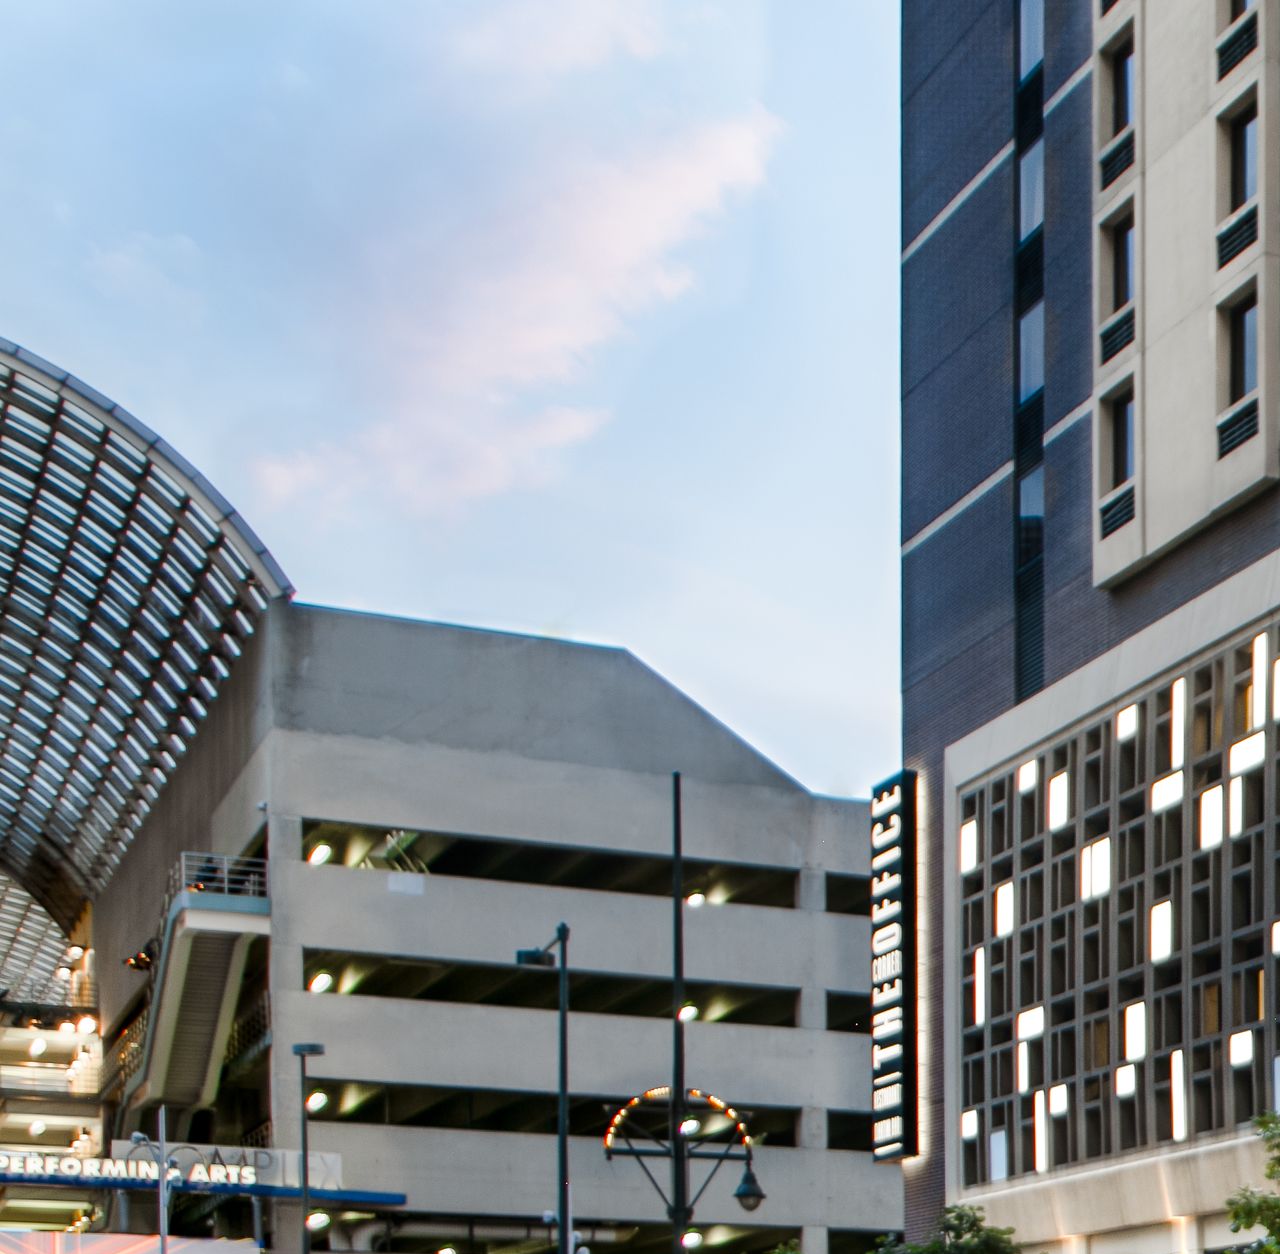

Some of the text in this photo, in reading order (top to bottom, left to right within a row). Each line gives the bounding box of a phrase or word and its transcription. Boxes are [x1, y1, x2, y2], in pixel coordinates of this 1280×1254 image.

[871, 783, 903, 957] OFFICE
[871, 979, 904, 1071] THE
[0, 1156, 257, 1185] PERFORMIN ARTS
